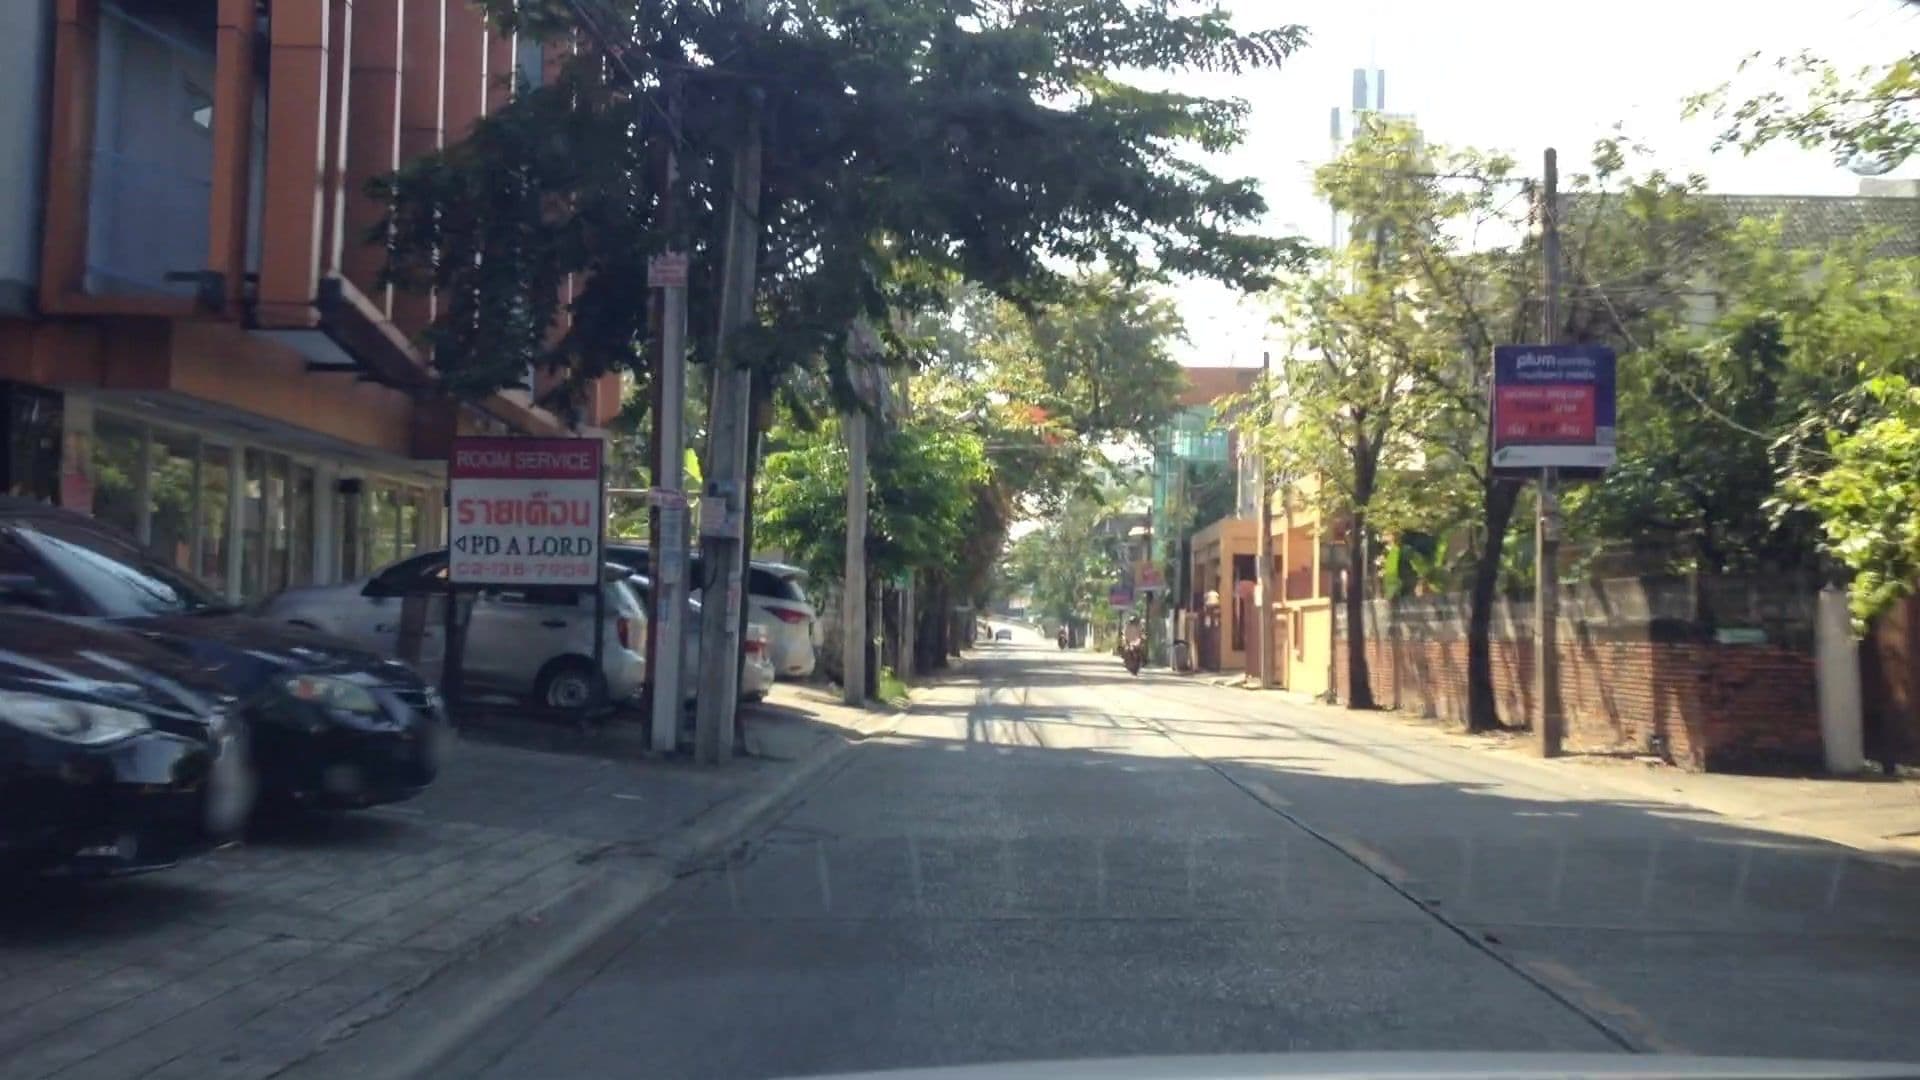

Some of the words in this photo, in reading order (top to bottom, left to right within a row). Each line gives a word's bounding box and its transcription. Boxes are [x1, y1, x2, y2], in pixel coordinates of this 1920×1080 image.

[457, 451, 510, 467] ROOM
[515, 452, 591, 469] SERVICE
[457, 491, 591, 526] รายเดือน
[472, 536, 500, 555] PD
[506, 536, 521, 556] A
[527, 536, 593, 557] LORD
